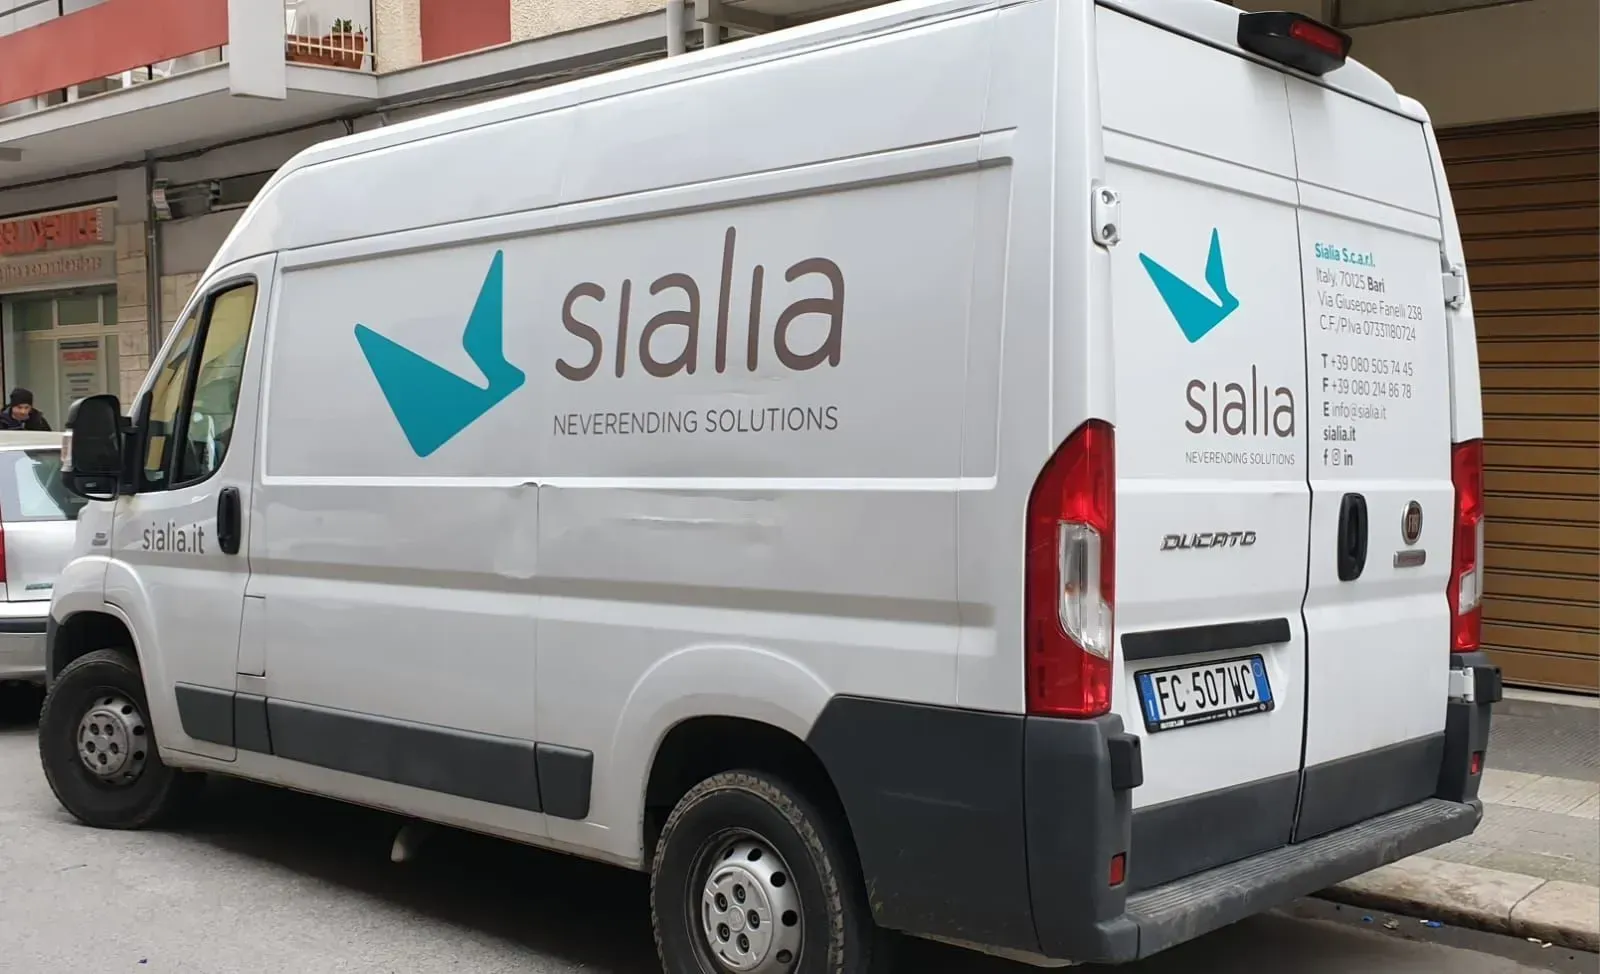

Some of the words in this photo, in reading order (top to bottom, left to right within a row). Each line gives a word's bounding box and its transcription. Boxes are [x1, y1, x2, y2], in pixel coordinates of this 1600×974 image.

[1315, 243, 1340, 261] Sialia
[1339, 271, 1365, 290] 70125
[1367, 277, 1385, 293] Bari
[555, 226, 845, 381] sialia
[1318, 290, 1333, 307] Via
[1335, 293, 1377, 315] Giuseppe
[1379, 301, 1406, 318] Fanelli
[1407, 304, 1422, 321] 238
[1363, 320, 1416, 341] 07331180724
[1321, 353, 1328, 368] T
[1331, 355, 1348, 371] +39
[1351, 356, 1369, 373] 080
[1371, 359, 1388, 375] 505
[1391, 360, 1400, 375] 74
[1403, 361, 1413, 377] 45
[1322, 377, 1329, 392] F
[1332, 378, 1349, 394] +39
[1351, 380, 1370, 396] 080
[1372, 381, 1386, 397] 214
[1388, 383, 1399, 398] 86
[1401, 384, 1412, 399] 78
[1185, 364, 1295, 438] sialia
[1323, 401, 1330, 417] E
[1332, 402, 1387, 421] info@sialia.it
[553, 410, 698, 436] NEVERENDING
[705, 406, 839, 433] SOLUTIONS
[1323, 425, 1356, 441] sialia.it
[1185, 451, 1248, 464] NEVERENDING
[1249, 453, 1295, 465] SOLUTIONS
[142, 522, 204, 554] sialia.it
[1160, 531, 1256, 551] DUCATO
[1155, 674, 1186, 716] FC
[1192, 664, 1255, 709] 507WC
